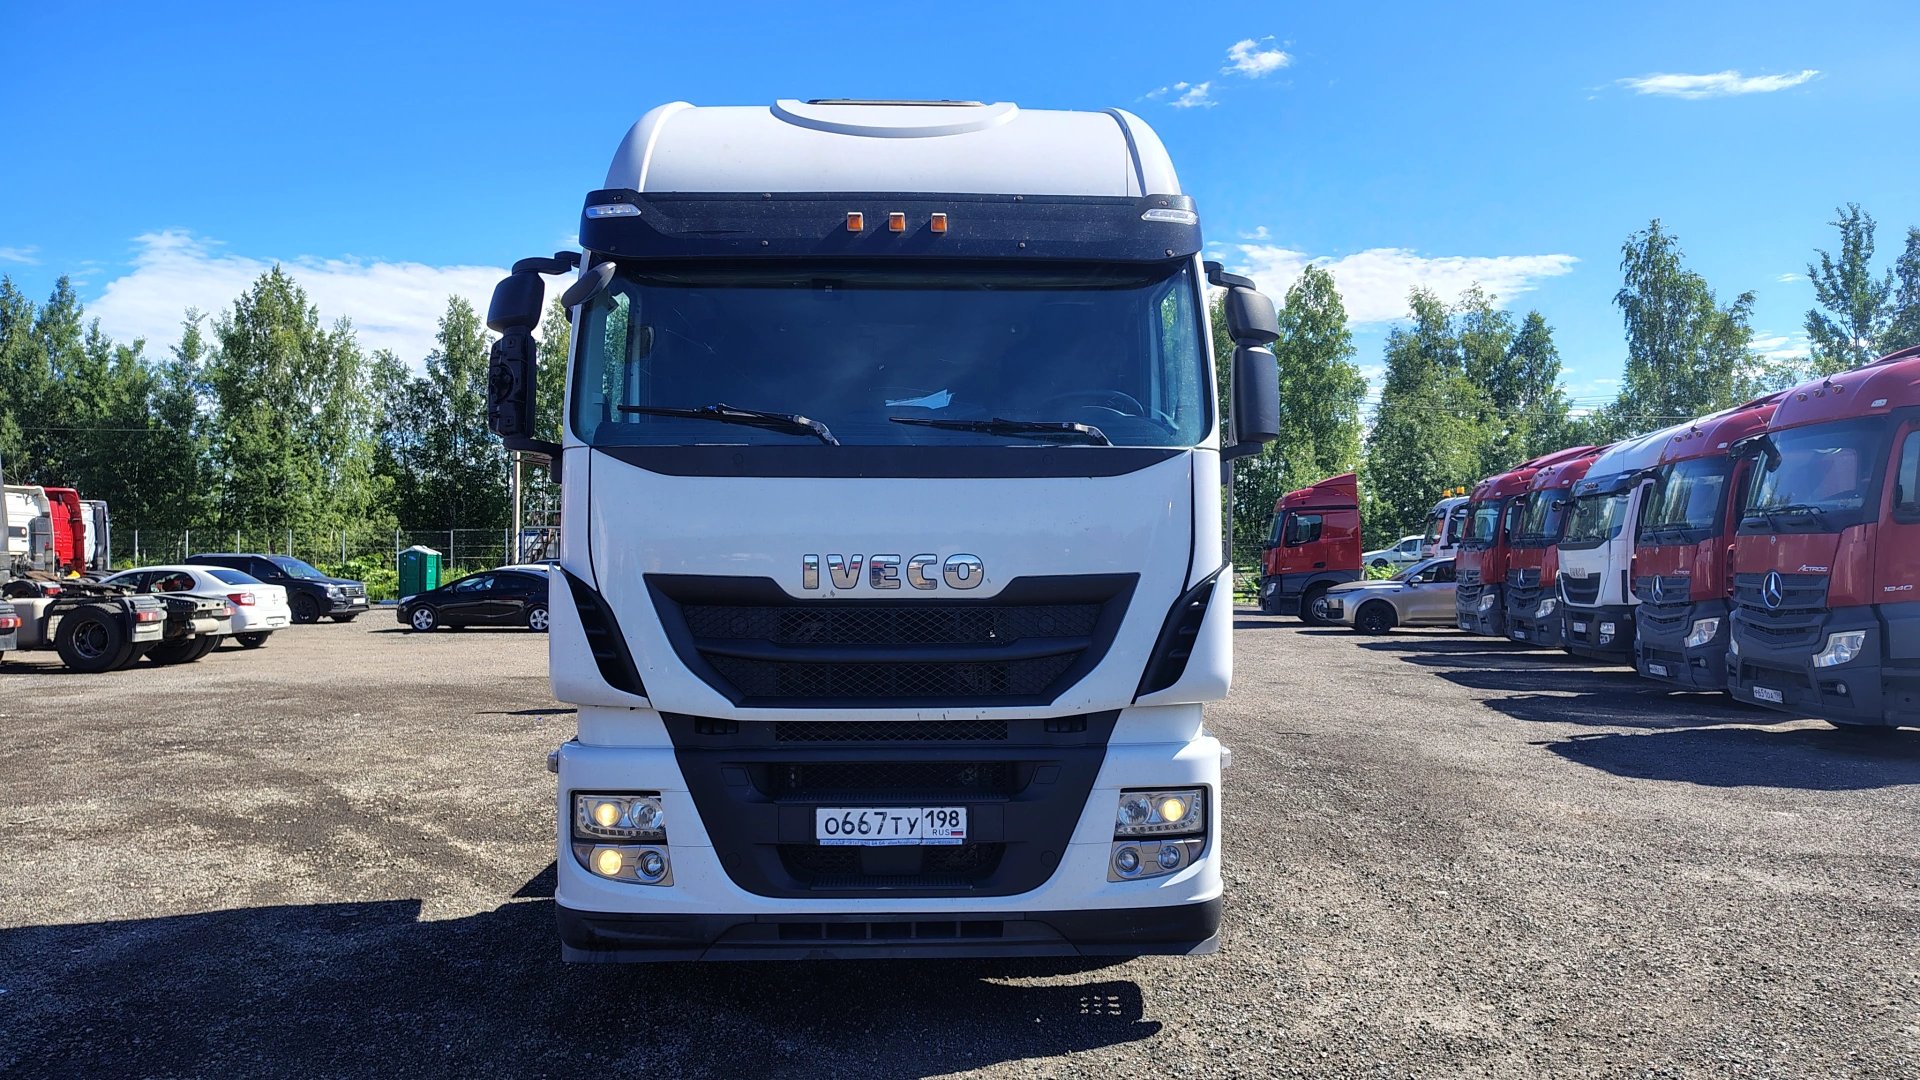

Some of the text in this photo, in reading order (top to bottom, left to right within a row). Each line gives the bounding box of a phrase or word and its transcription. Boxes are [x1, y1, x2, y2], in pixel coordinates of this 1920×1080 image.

[803, 553, 985, 590] IVECO
[925, 809, 960, 828] 198
[932, 828, 950, 836] RUS
